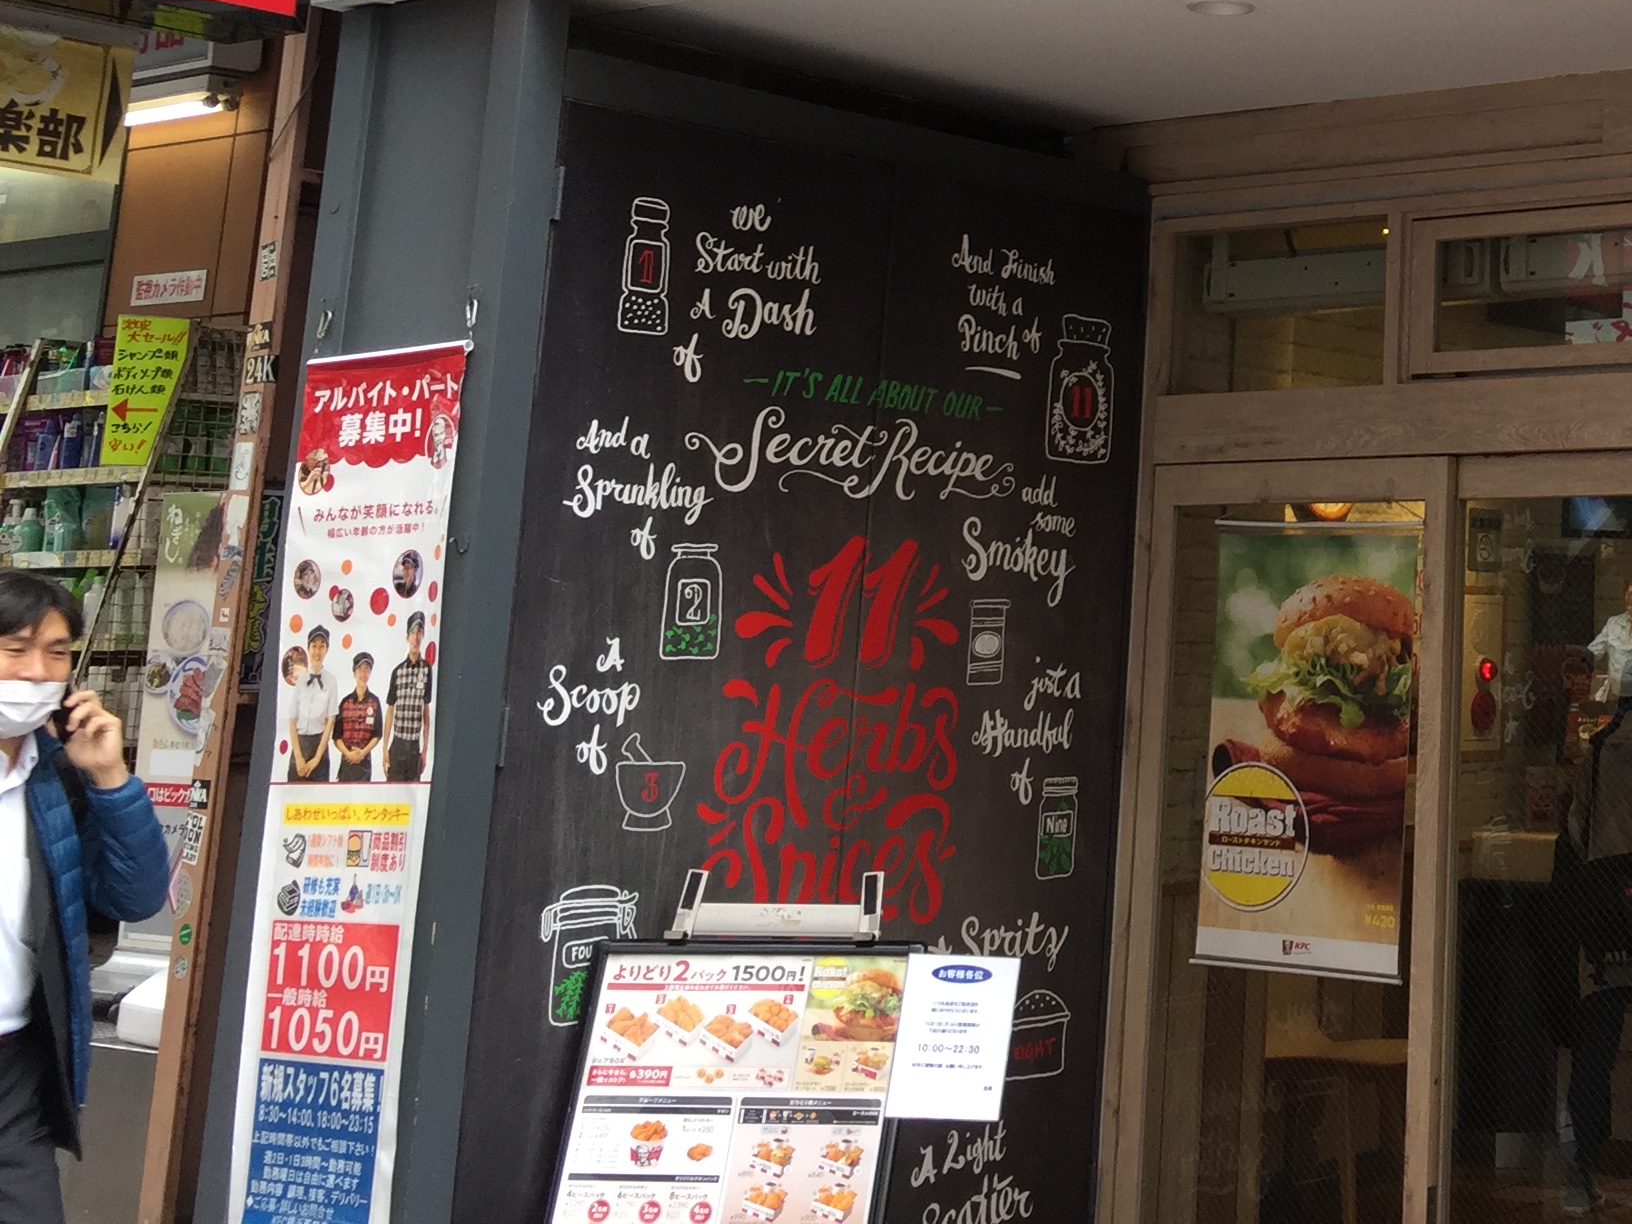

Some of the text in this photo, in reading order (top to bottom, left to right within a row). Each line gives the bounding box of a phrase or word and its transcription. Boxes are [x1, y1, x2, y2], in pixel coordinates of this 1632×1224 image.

[0, 97, 87, 161] 楽部
[695, 231, 821, 284] Start with
[952, 234, 1056, 286] And Finish
[690, 287, 817, 339] A Dash
[968, 284, 1007, 316] with
[673, 332, 703, 382] of
[958, 314, 1042, 360] Pinch of
[111, 384, 166, 396] 石けん類
[314, 374, 458, 413] アルバイト・パート
[772, 368, 983, 420] IT'S ALL ABOUT OUR
[576, 416, 650, 458] And a
[685, 406, 1015, 500] Secret Recipe
[1022, 474, 1057, 506] add
[631, 516, 656, 559] of
[1031, 512, 1076, 537] some
[961, 516, 1076, 607] Smokey
[805, 535, 921, 670] 11
[596, 637, 624, 672] A
[537, 664, 640, 727] Scoop
[1023, 656, 1067, 710] just
[576, 724, 608, 775] of
[713, 678, 959, 828] Herbs
[972, 708, 1074, 756] Handful
[1010, 758, 1035, 805] of
[1209, 797, 1297, 838] Roast
[373, 832, 407, 852] 商品割引
[700, 793, 951, 924] Spices
[1207, 848, 1295, 877] Chicken
[1221, 836, 1282, 847] ローストチキンサンド
[273, 922, 344, 943] 配達時時給
[1364, 913, 1395, 929] ¥420
[273, 942, 390, 992] 1100円
[938, 969, 984, 980] お客様各位
[267, 987, 328, 1008] 一般時給
[268, 1006, 384, 1058] 1050円
